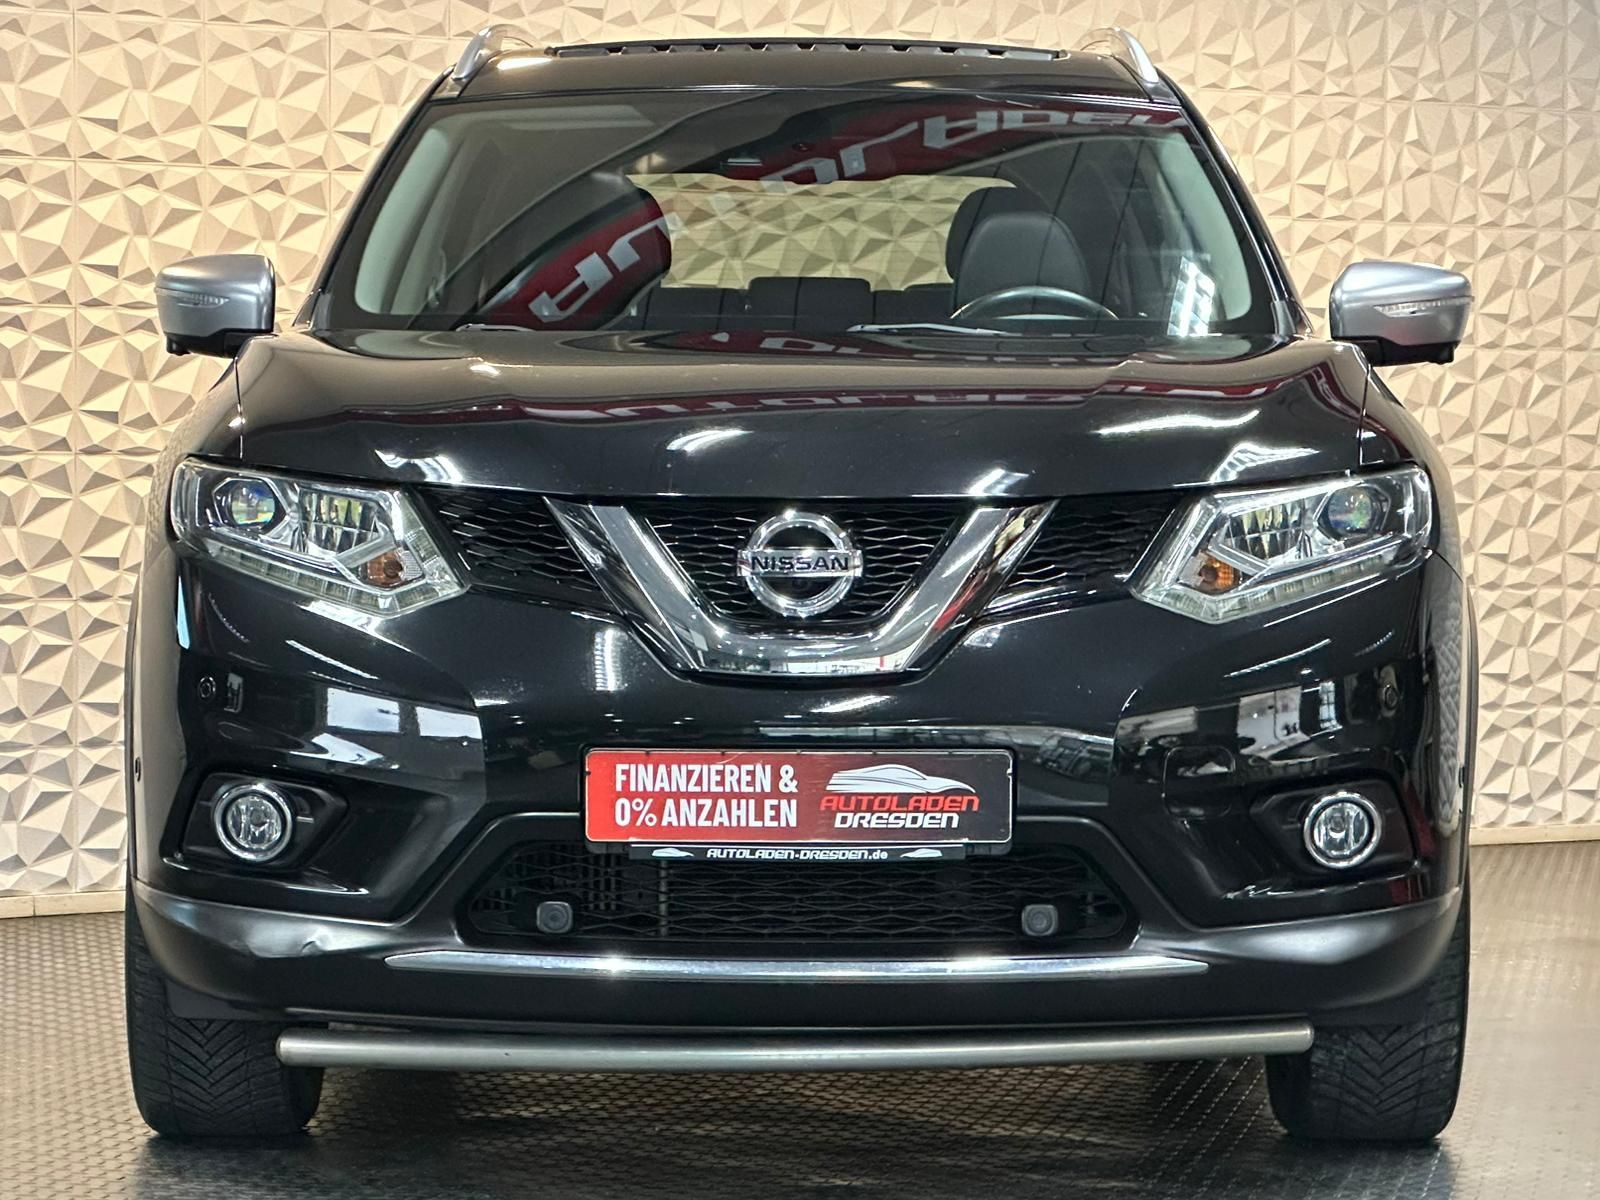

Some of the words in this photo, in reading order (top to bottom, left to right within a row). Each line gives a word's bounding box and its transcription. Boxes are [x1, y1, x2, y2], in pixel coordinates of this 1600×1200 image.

[751, 556, 849, 571] NISSAN
[615, 764, 772, 793] FINANZIEREN
[778, 764, 799, 793] &
[819, 795, 980, 812] AUTOLADEN
[615, 797, 657, 827] 0%
[661, 798, 797, 828] ANZAHLEN
[834, 812, 960, 829] DRESDEN
